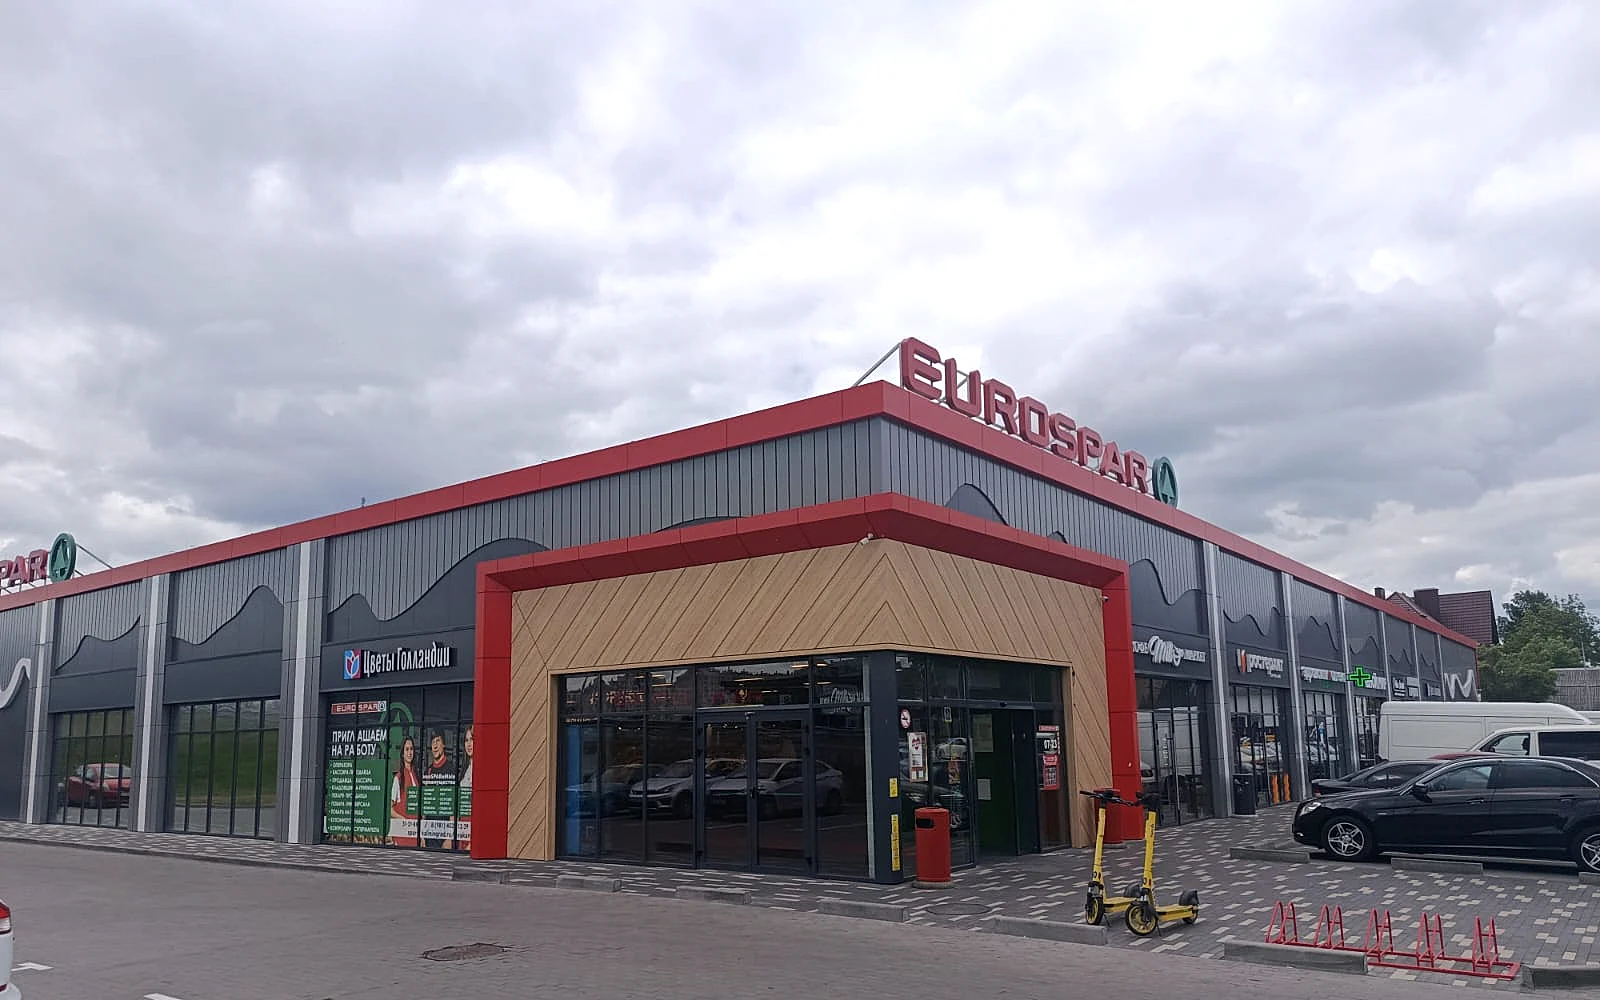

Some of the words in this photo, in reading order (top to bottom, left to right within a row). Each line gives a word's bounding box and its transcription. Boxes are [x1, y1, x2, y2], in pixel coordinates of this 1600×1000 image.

[900, 336, 1149, 494] EUROSPAR
[363, 650, 395, 678] Цветы
[397, 641, 450, 671] Голландии
